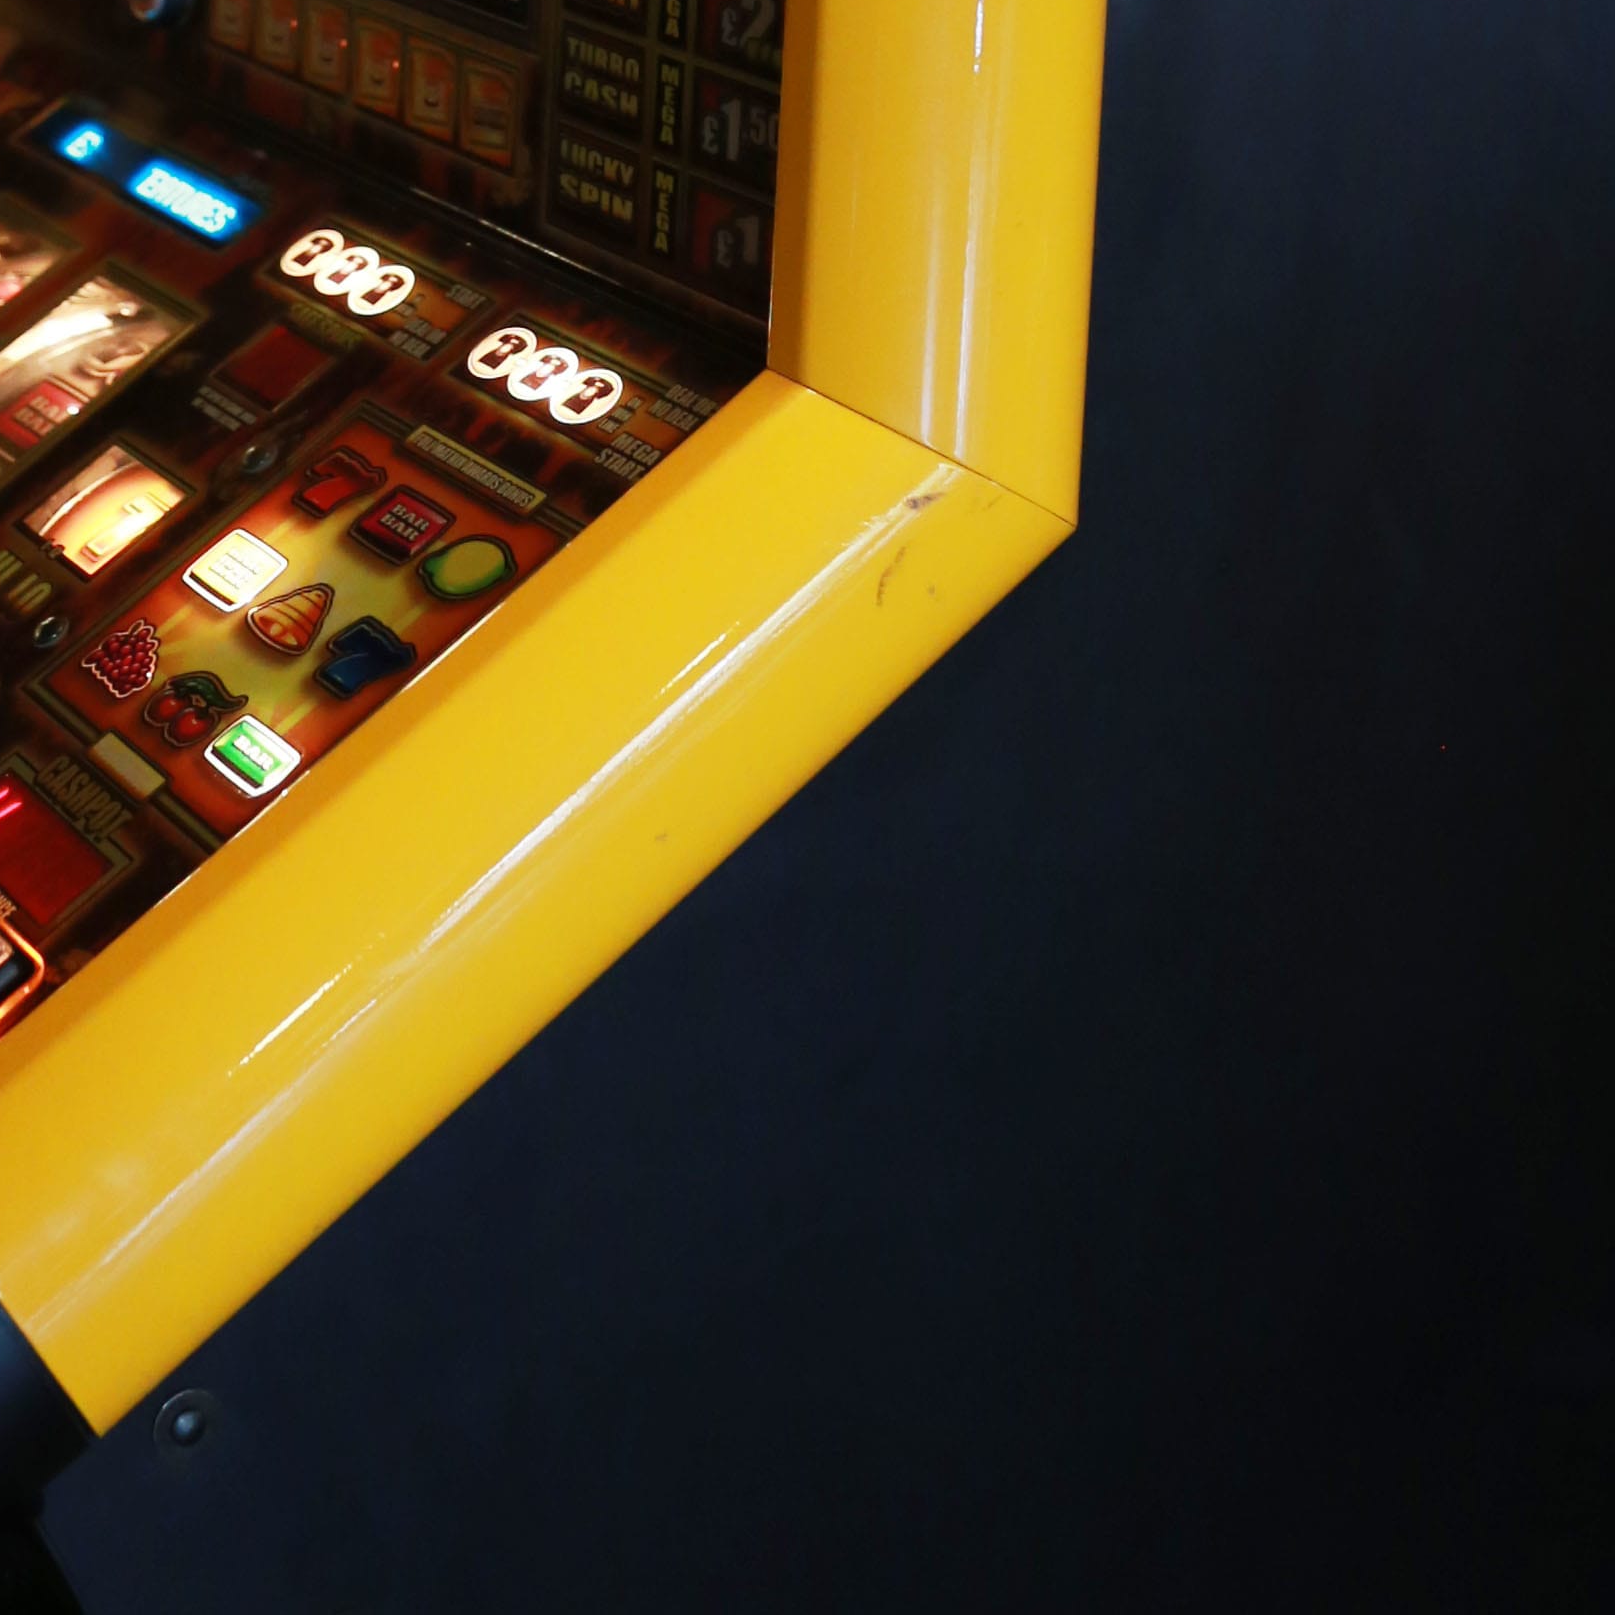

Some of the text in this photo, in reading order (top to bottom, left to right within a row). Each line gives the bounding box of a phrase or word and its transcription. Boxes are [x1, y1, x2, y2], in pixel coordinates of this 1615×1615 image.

[566, 36, 641, 83] TURBO
[563, 70, 639, 118] CASH
[659, 63, 680, 146] MEGA
[559, 138, 635, 187] LUCKY
[558, 172, 634, 223] SPIN
[654, 169, 676, 254] MEGA
[715, 215, 760, 269] £1
[648, 398, 699, 432] NO DEAL
[664, 383, 695, 409] DEAL
[414, 433, 434, 452] FULL
[460, 459, 503, 490] AWARDS
[496, 477, 534, 508] BONUS
[594, 448, 646, 481] START
[610, 432, 663, 467] MEGA
[379, 513, 420, 542] BAR
[391, 503, 430, 532] BAR
[233, 734, 274, 772] BAR
[35, 754, 134, 842] CASHPOT
